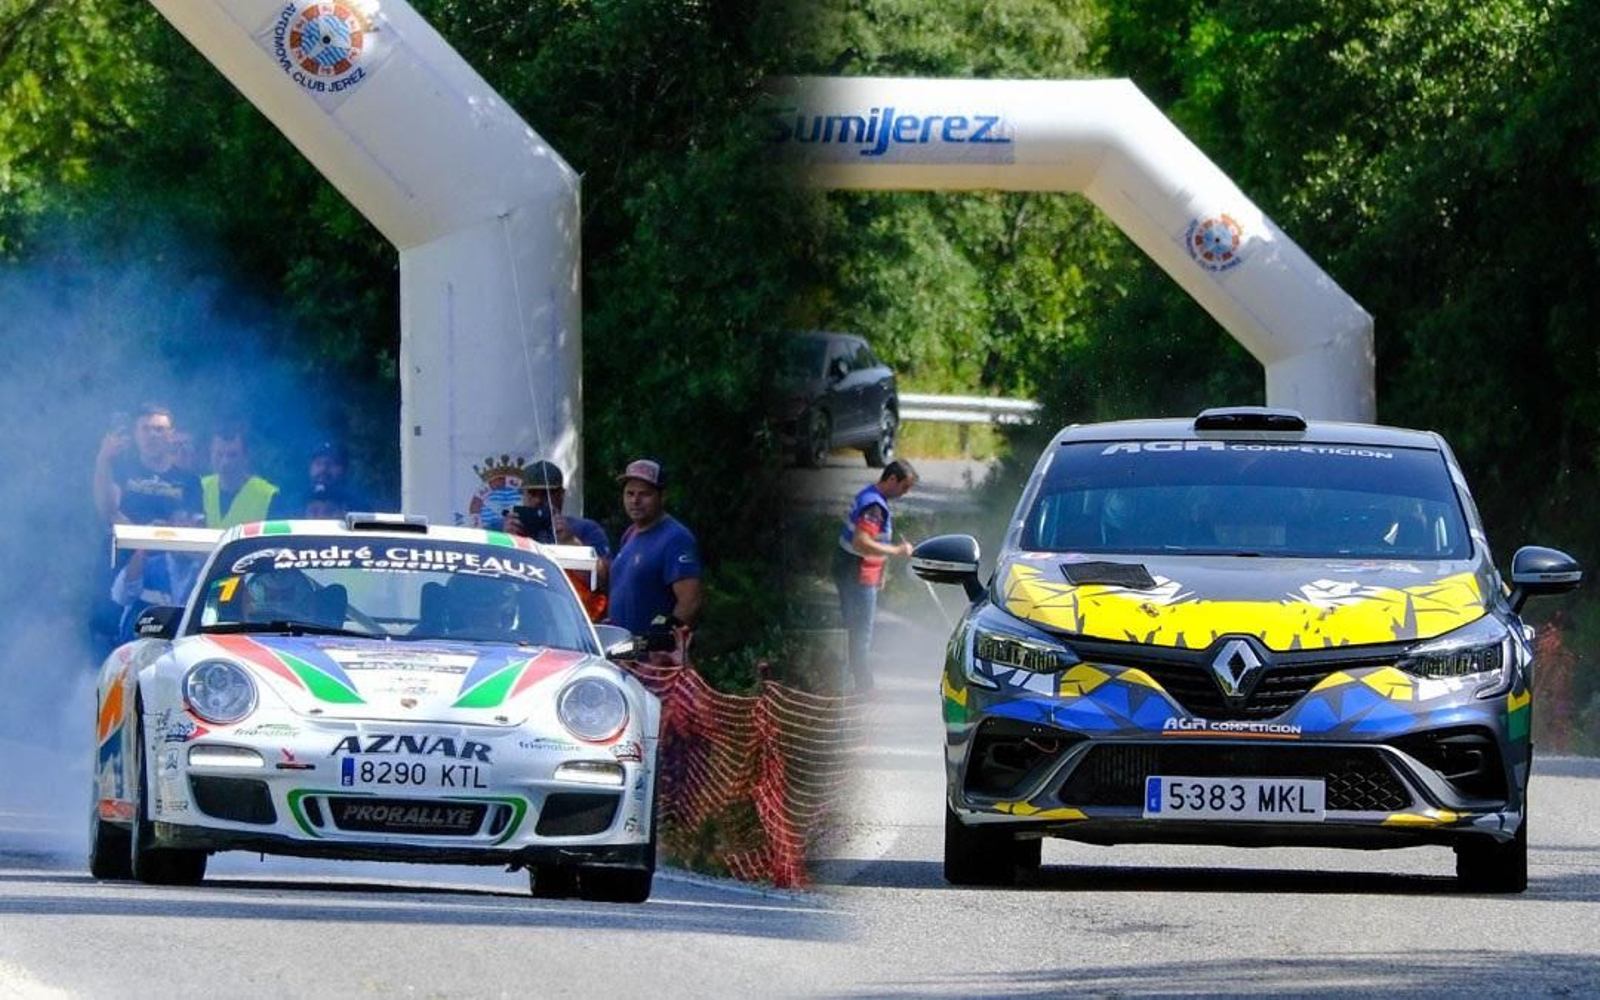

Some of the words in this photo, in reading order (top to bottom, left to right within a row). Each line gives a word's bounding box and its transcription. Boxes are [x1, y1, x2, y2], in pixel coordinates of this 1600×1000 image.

[275, 3, 296, 74] AUTOMOVIL
[292, 73, 325, 92] CLUB
[328, 68, 366, 92] JEREZ
[1230, 444, 1394, 459] COMPETICION
[274, 546, 372, 562] André
[386, 548, 546, 580] CHIPEAUX
[274, 560, 352, 569] MOTOR
[361, 560, 459, 571] CONCEPT
[218, 577, 240, 602] 1
[1210, 722, 1302, 734] COMPETICION
[331, 735, 493, 764] AZNAR
[360, 761, 426, 785] 8290
[440, 765, 487, 788] KTL
[1170, 783, 1245, 811] 5383
[1258, 785, 1315, 813] MKL
[343, 804, 474, 825] PRORALLYE
